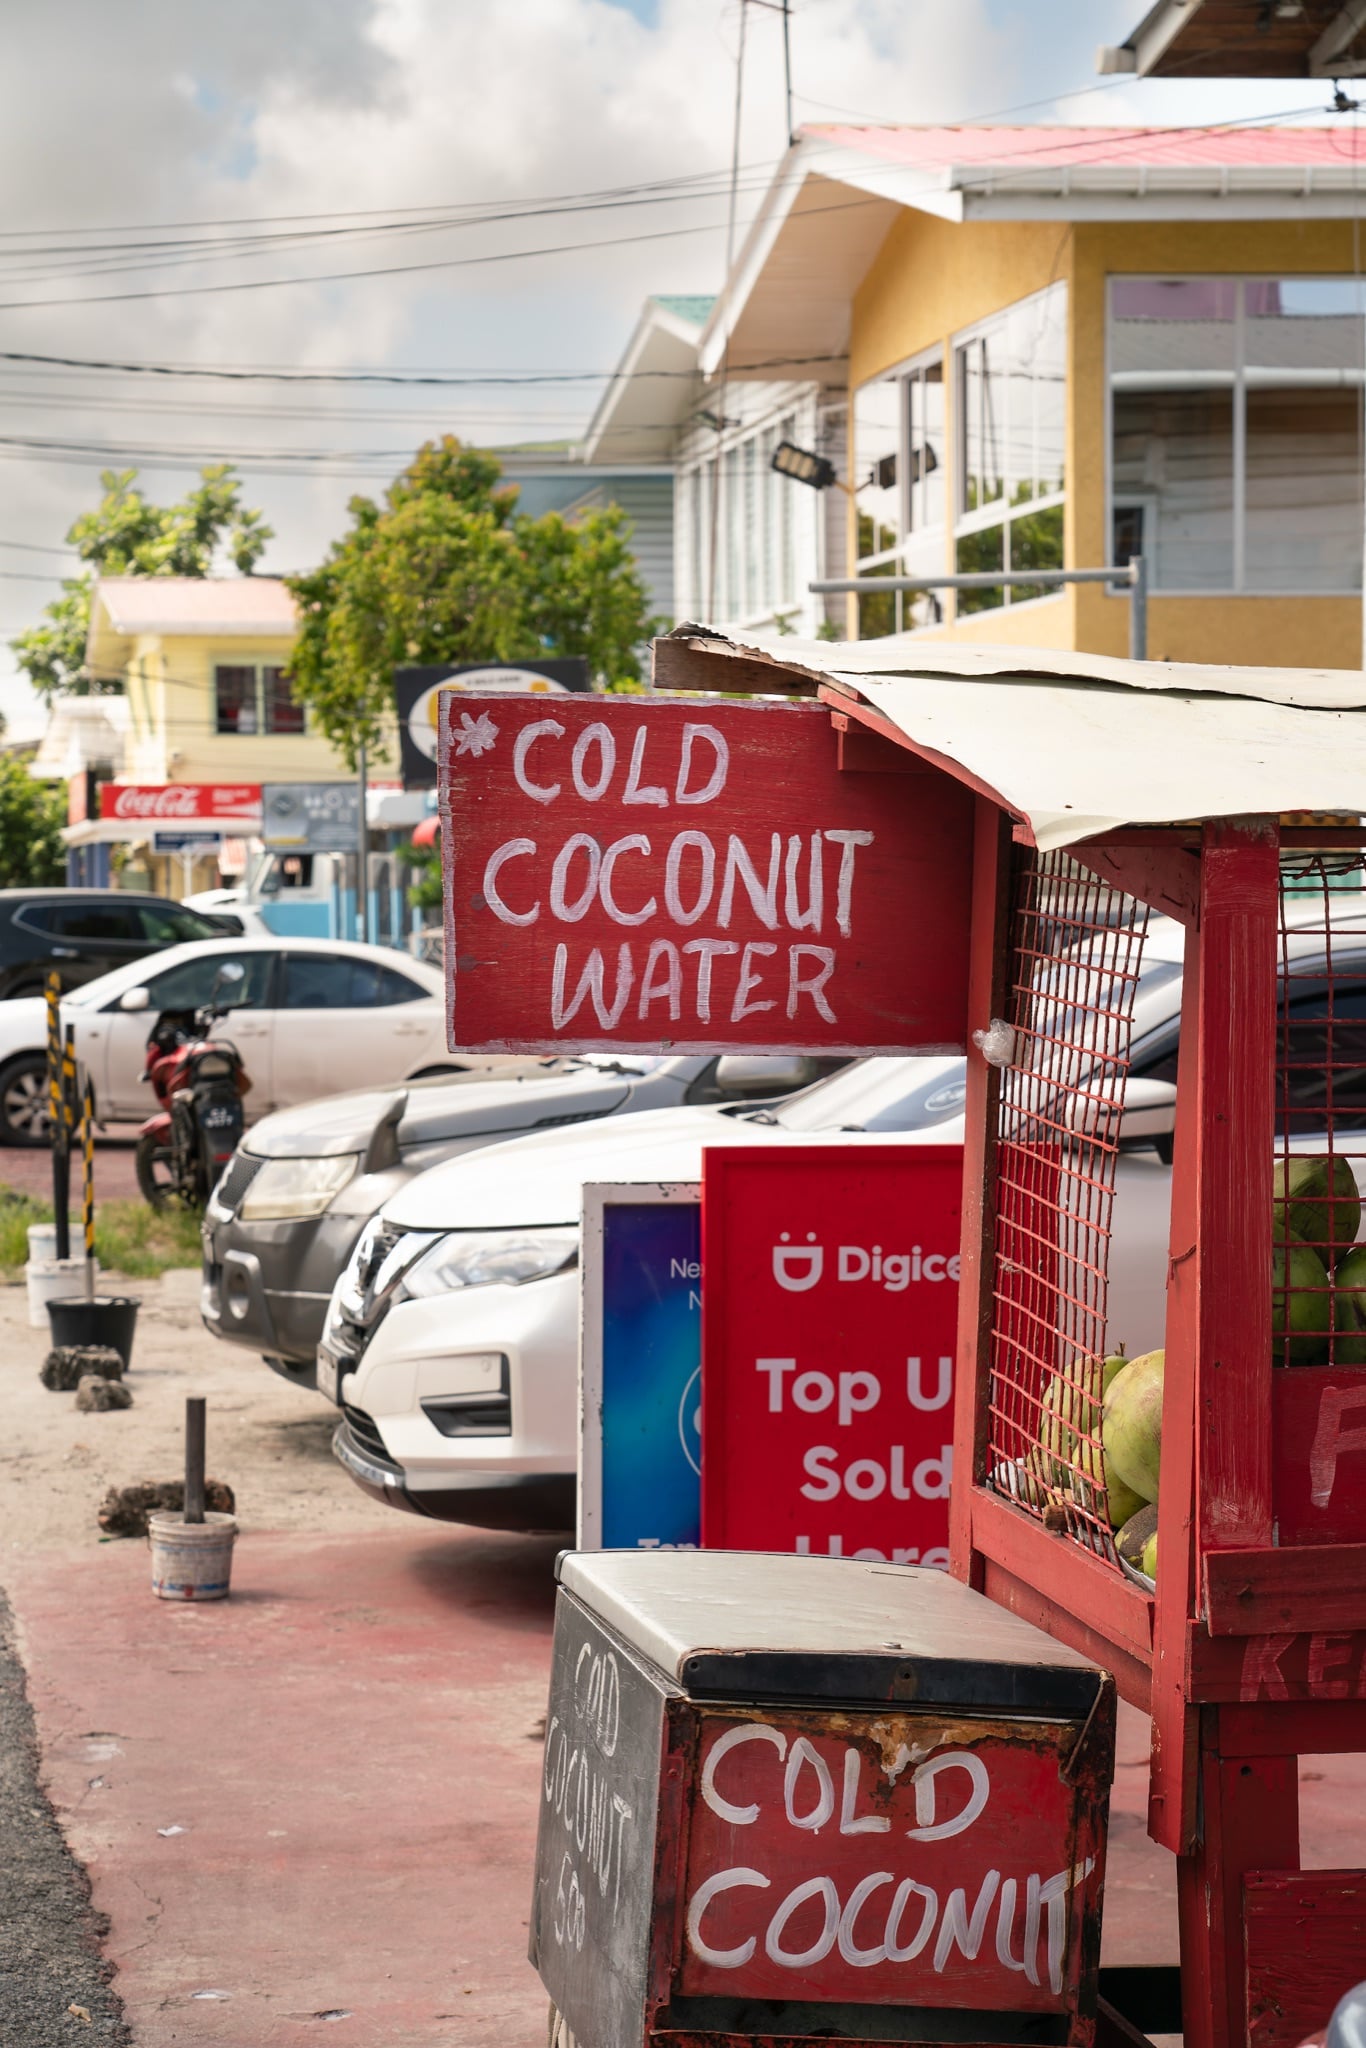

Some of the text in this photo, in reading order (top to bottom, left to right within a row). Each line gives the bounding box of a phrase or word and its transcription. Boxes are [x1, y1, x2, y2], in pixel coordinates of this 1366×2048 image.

[513, 718, 729, 808] COLD
[483, 829, 875, 938] COCONUT
[551, 938, 838, 1031] WATER
[756, 1358, 881, 1426] Top
[800, 1445, 954, 1501] Sold
[702, 1723, 990, 1842] COLD
[686, 1856, 1096, 1995] COCONUT
